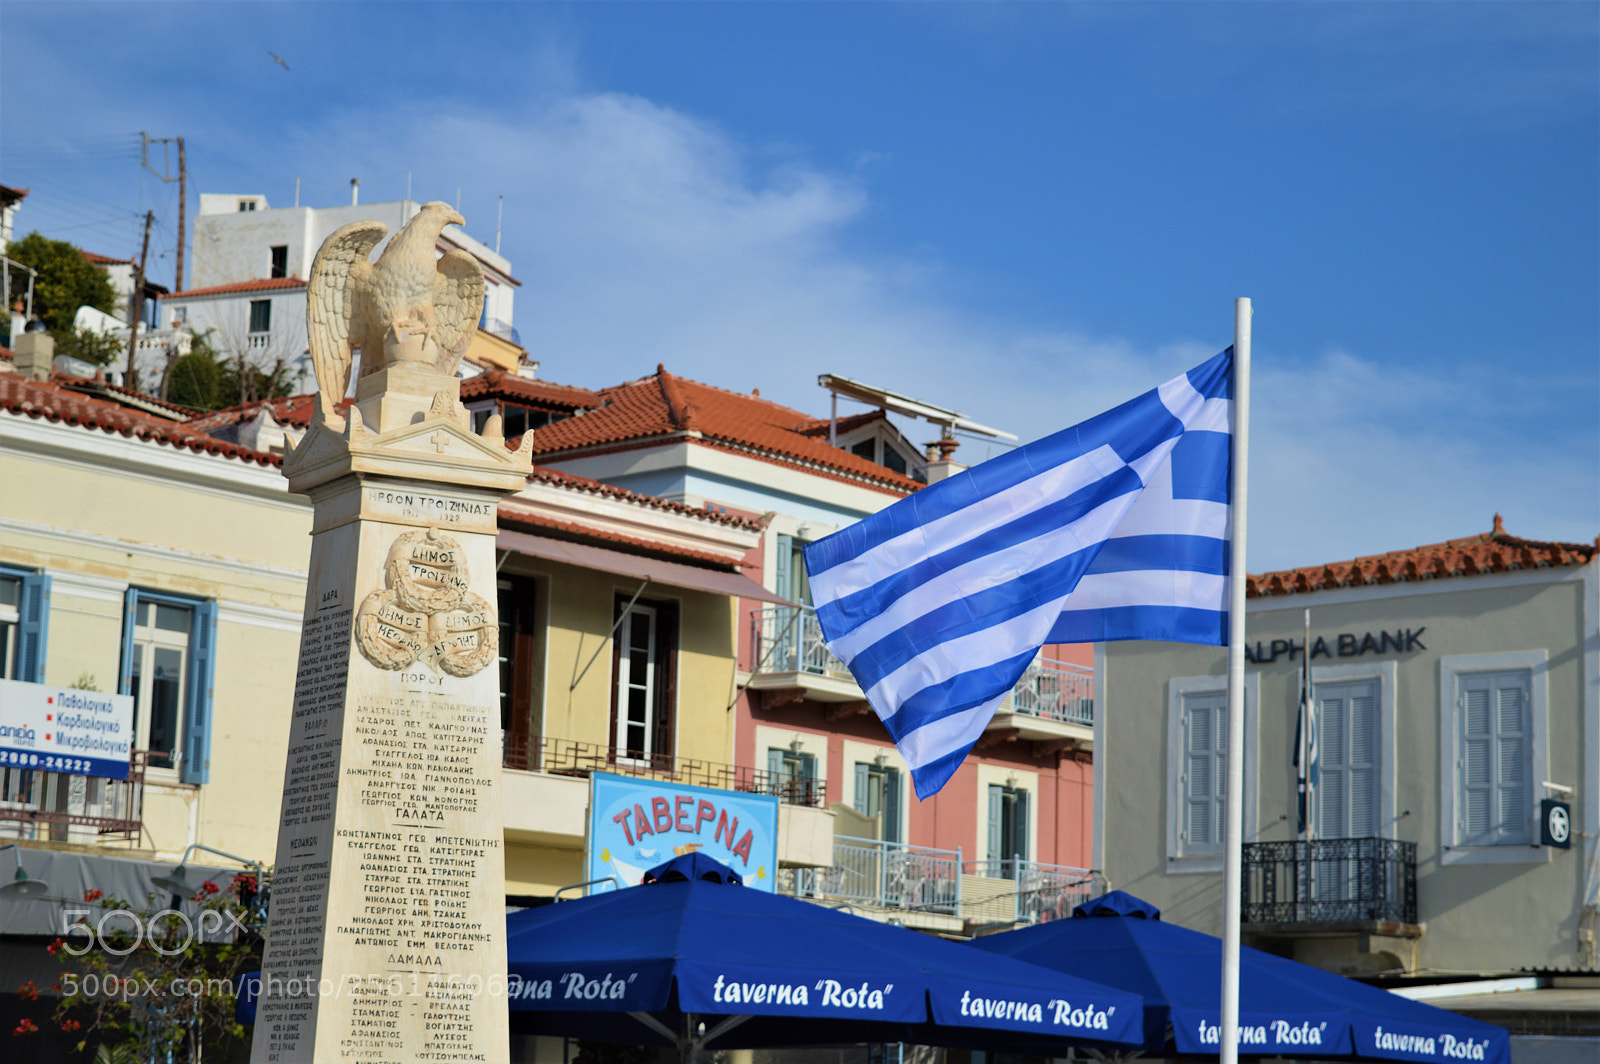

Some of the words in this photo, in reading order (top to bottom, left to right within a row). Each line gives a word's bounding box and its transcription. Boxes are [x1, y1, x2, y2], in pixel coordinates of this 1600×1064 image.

[412, 547, 456, 563] ΔΗΜΟΣ
[378, 605, 422, 629] ΔΗΜΟΣ
[445, 613, 488, 628] ΔΗΜΟΣ
[1337, 626, 1427, 657] BANK
[401, 673, 443, 685] ΠΟΡΟΥ
[58, 692, 113, 715] Παθολογικό
[57, 712, 120, 734] Καρδιολογικό
[56, 731, 128, 755] Μικροβιολογικό
[362, 738, 408, 748] ΑΘΑΝΑΣΙΟΣ
[376, 749, 424, 760] ΕΥΑΓΓΕΛΟΣ
[346, 768, 392, 778] ΔΗΜΗΤΡΙΟΣ
[425, 774, 493, 787] ΓΙΑΝΝΟΠΟΥΛΟΣ
[361, 790, 401, 800] ΓΕΩΡΓΙΟΣ
[362, 799, 396, 807] ΓΕΩΡΓΙΟΣ
[396, 808, 444, 821] ΓΑΛΑΤΑ
[336, 829, 402, 841] ΚΩΝΣΤΑΝΤΙΝΟΣ
[613, 795, 753, 866] ΤΑΒΕΡΝΑ
[348, 841, 396, 851] ΕΥΑΓΓΕΛΟΣ
[363, 852, 401, 862] ΙΩΑΝΝΗΣ
[429, 857, 476, 868] ΣΤΡΑΤΙΚΗΣ
[360, 864, 408, 873] ΑΘΑΝΑΣΙΟΣ
[432, 868, 477, 878] ΣΤΡΑΤΙΚΗΣ
[365, 874, 401, 883] ΣΤΑΥΡΟΣ
[427, 878, 469, 888] ΣΤΡΑΤΙΚΗΣ
[364, 884, 405, 894] ΓΕΩΡΓΙΟΣ
[365, 895, 408, 905] ΝΙΚΟΛΑΟΣ
[365, 906, 406, 915] ΓΕΩΡΓΙΟΣ
[433, 910, 467, 919] ΤΖΑΚΑΣ
[352, 917, 394, 926] ΝΙΚΟΛΑΟΣ
[421, 920, 482, 930] ΧΡΙΣΤΟΔΟΥΛΟΥ
[337, 926, 391, 937] ΠΑΝΑΓΙΩΤΗΣ
[423, 931, 492, 942] ΜΑΚΡΟΓΙΑΝΝΗΣ
[354, 938, 399, 947] ΑΝΤΩΝΙΟΣ
[435, 941, 475, 951] ΒΕΛΟΤΑΣ
[388, 954, 443, 967] ΔΑΜΑΛΑ
[713, 974, 809, 1005] taverna
[814, 979, 893, 1010] "Rota"
[352, 998, 403, 1008] ΔΗΜΗΤΡΙΟΣ
[352, 1008, 400, 1018] ΣΤΑΜΑΤΙΟΣ
[423, 1012, 471, 1021] ΓΑΛΟΥΤΖΗΣ
[960, 990, 1043, 1023] taverna
[1047, 999, 1116, 1030] "Rota"
[351, 1019, 398, 1028] ΣΤΑΜΑΤΙΟΣ
[351, 1029, 401, 1039] ΑΘΑΝΑΣΙΟΣ
[1198, 1019, 1267, 1045] tarna
[1374, 1025, 1436, 1055] taverna
